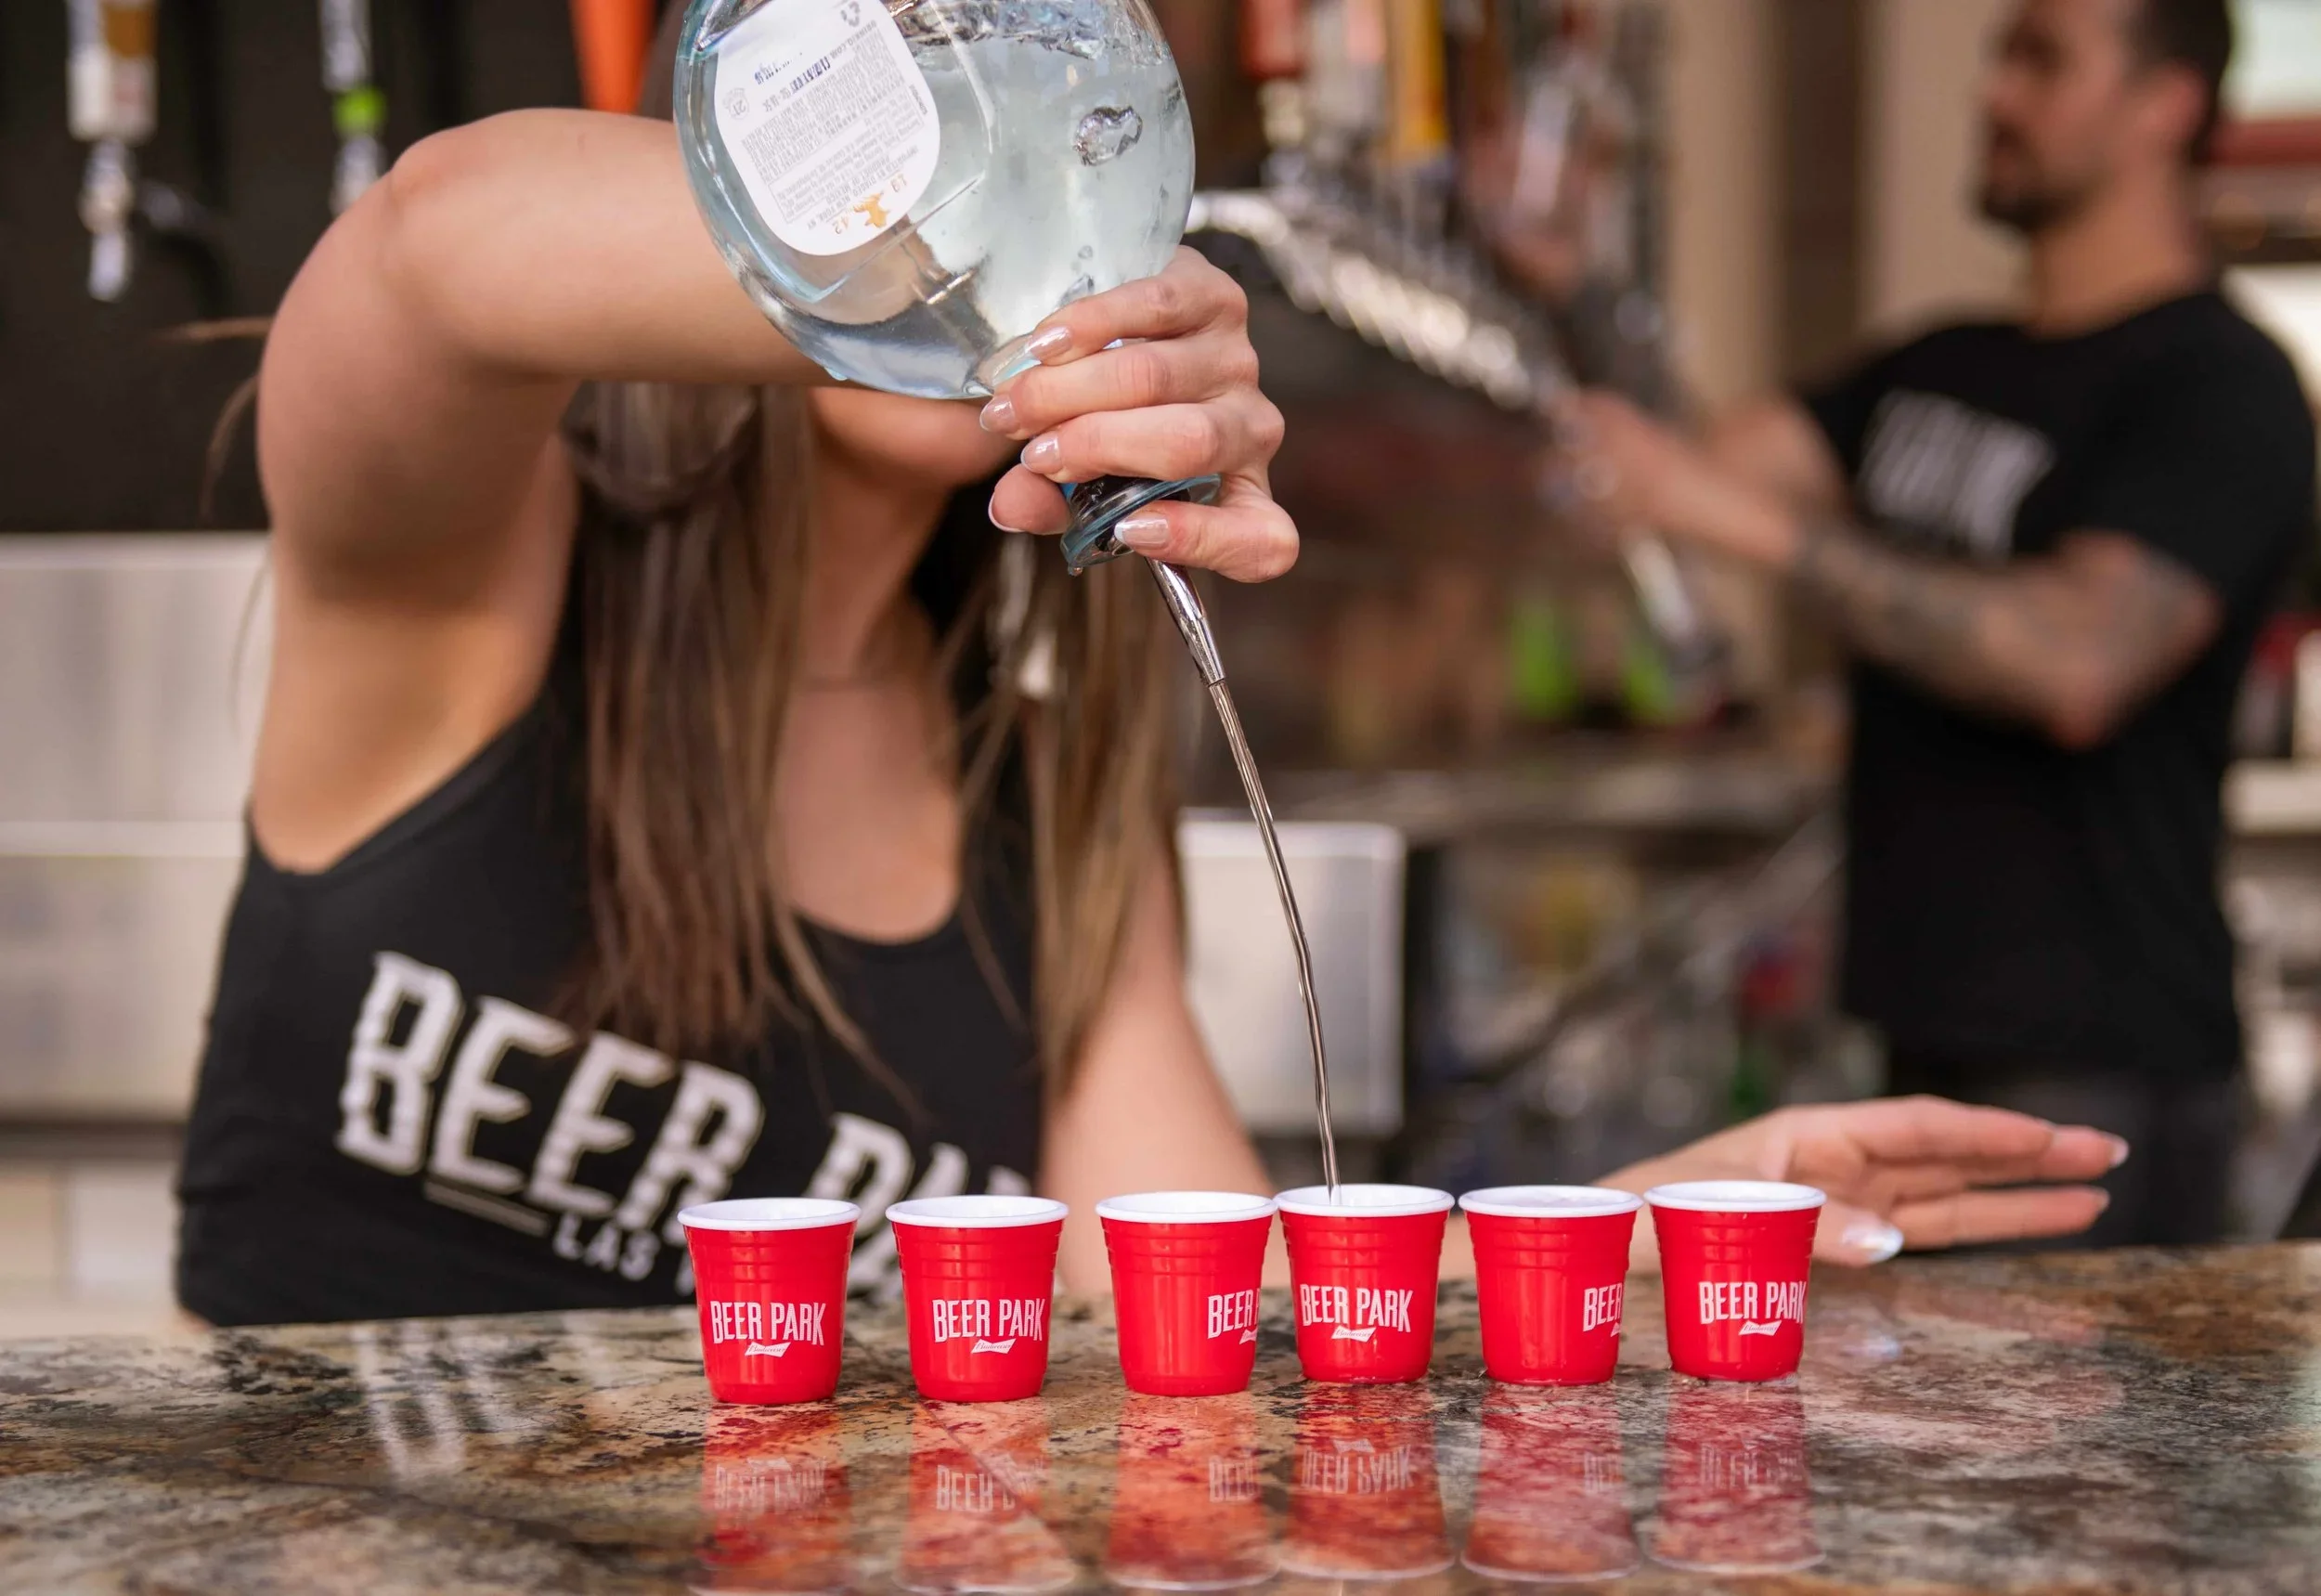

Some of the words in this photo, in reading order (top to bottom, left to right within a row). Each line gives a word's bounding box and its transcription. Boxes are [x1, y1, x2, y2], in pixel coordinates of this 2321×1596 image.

[732, 98, 748, 116] 21
[336, 950, 766, 1251] BEER
[552, 1213, 659, 1282] LAS
[710, 1300, 762, 1344] BEER
[771, 1302, 826, 1346] PARK
[932, 1299, 990, 1343] BEER
[998, 1298, 1045, 1342] PARK
[1207, 1289, 1253, 1340] BEER
[1300, 1283, 1349, 1327] BEER
[1356, 1287, 1413, 1333] PARK
[1583, 1282, 1622, 1332] BEER
[1699, 1280, 1757, 1325] BEER
[1765, 1280, 1807, 1324] PARK
